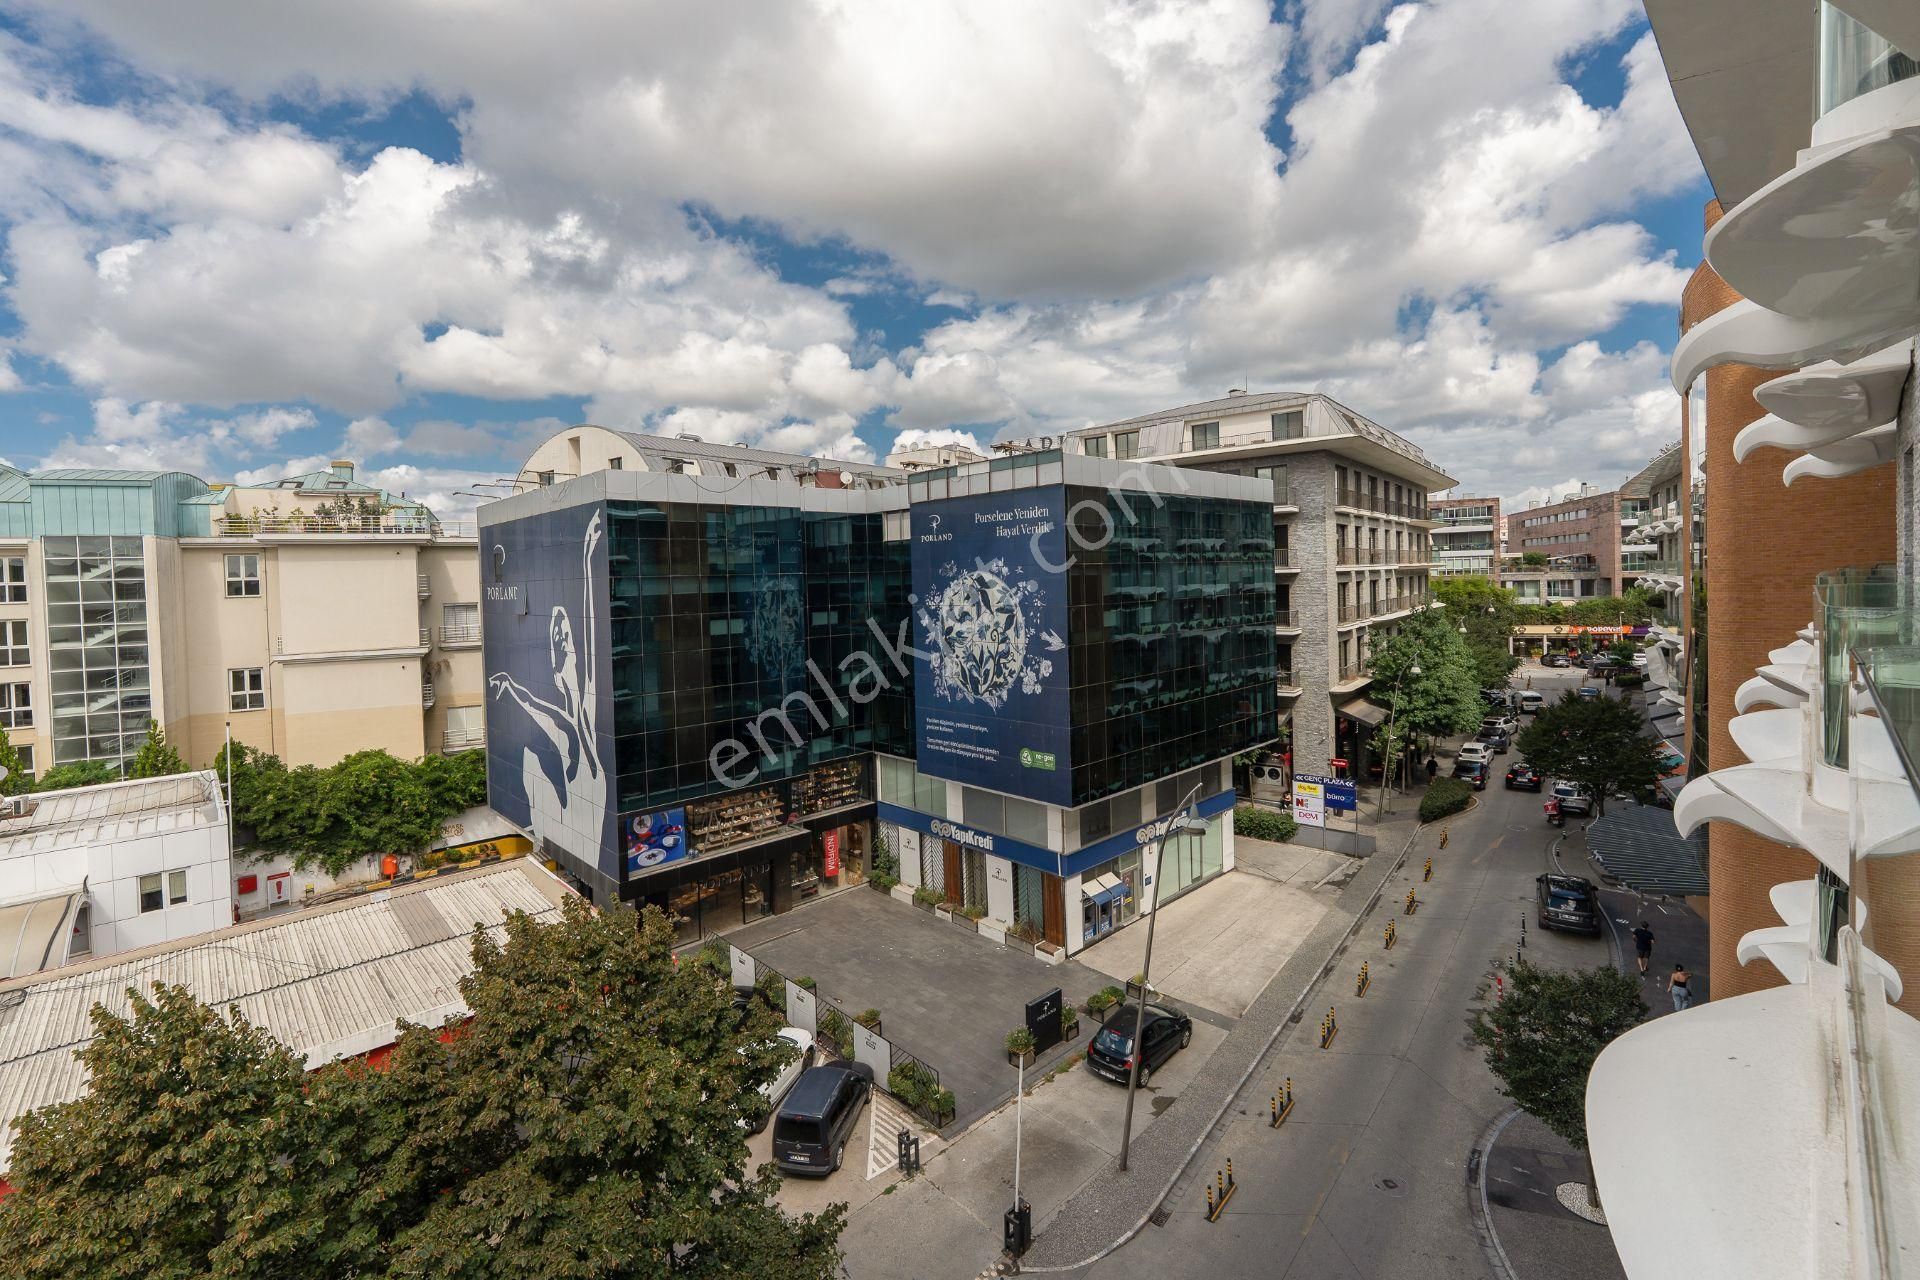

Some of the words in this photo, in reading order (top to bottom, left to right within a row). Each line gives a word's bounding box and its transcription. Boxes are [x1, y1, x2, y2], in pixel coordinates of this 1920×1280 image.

[975, 511, 1013, 523] Porselene
[1014, 506, 1049, 520] Yeniden
[1021, 521, 1050, 535] Verdik
[921, 533, 953, 543] PORLAND
[1304, 775, 1322, 784] GENÇ
[1323, 777, 1345, 786] PLAZA
